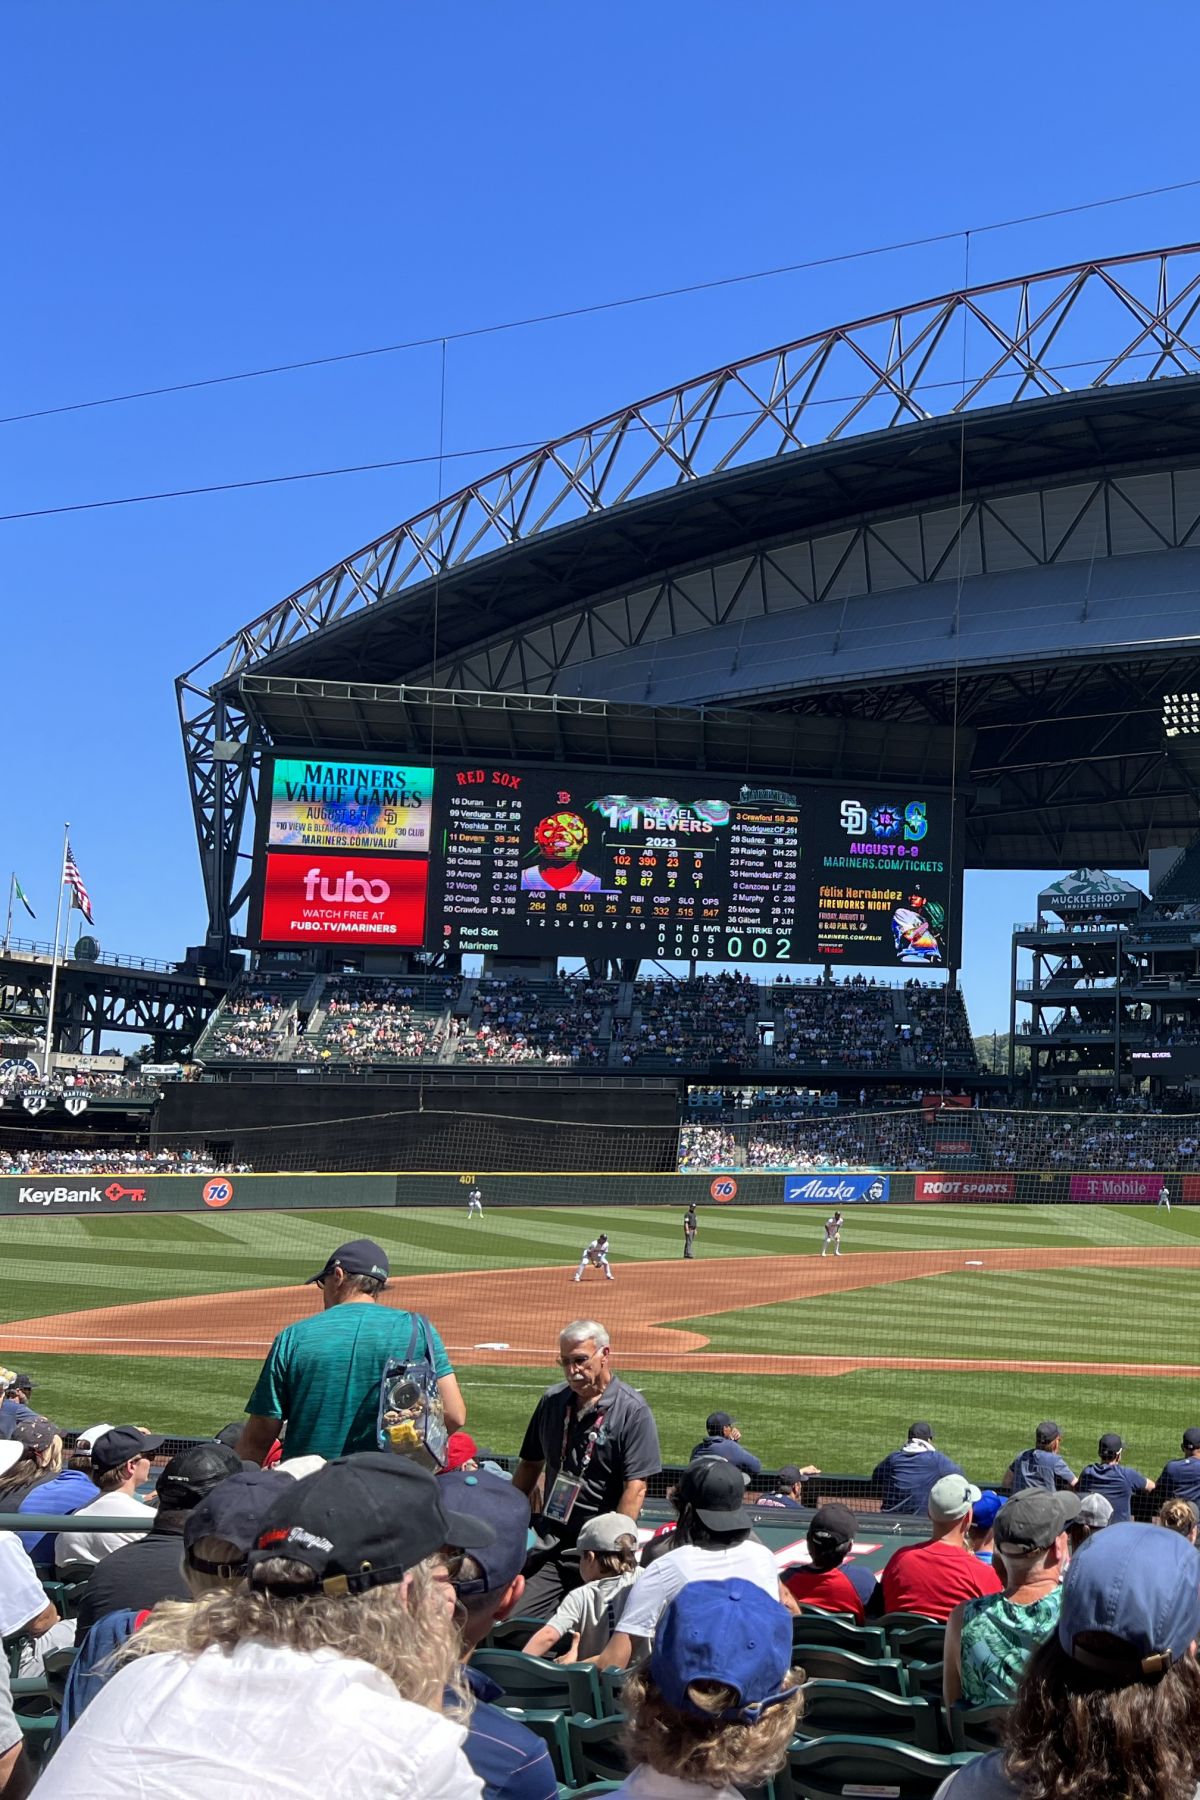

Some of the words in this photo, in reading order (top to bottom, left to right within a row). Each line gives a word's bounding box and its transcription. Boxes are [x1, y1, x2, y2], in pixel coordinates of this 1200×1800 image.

[305, 764, 406, 788] MARINERS
[456, 770, 485, 785] RED
[492, 771, 523, 790] SOX
[285, 782, 348, 803] VALUE
[354, 785, 422, 808] GAMES
[462, 798, 484, 806] Duran
[307, 807, 345, 820] AUGUST
[644, 808, 695, 820] RAFAEL
[880, 814, 893, 824] VS.
[289, 822, 306, 831] VIEW
[643, 818, 713, 833] DEVERS
[408, 828, 424, 837] CLUB
[302, 834, 398, 848] MARINERS.COM/VALUE
[645, 837, 677, 847] 2023
[850, 842, 895, 856] AUGUST
[613, 856, 631, 866] 102
[639, 857, 656, 866] 390
[667, 858, 679, 867] 23
[695, 860, 702, 868] 0
[824, 856, 944, 872] MARINERS.COM/TICKETS
[457, 870, 481, 879] Arroyo
[304, 868, 390, 904] fubo
[456, 883, 477, 891] Wong
[615, 877, 627, 886] 36
[640, 878, 653, 887] 87
[668, 879, 675, 888] 2
[695, 880, 700, 888] 1
[739, 894, 764, 902] Murphy
[820, 886, 843, 898] Félix
[846, 886, 903, 900] Hernández
[1051, 894, 1127, 904] MUCKLESHOOT
[455, 895, 479, 904] Chang
[678, 897, 694, 905] SLG
[819, 899, 864, 910] FIREWORKS
[868, 902, 891, 911] NIGHT
[454, 906, 488, 914] Crawford
[556, 903, 567, 911] 58
[579, 904, 594, 912] 103
[605, 905, 617, 913] 25
[303, 908, 340, 919] WATCH
[344, 910, 368, 920] FREE
[372, 911, 384, 921] AT
[290, 921, 397, 933] FUBO.TV/MARINERS
[726, 926, 744, 934] BALL
[746, 927, 773, 935] STRIKE
[460, 927, 478, 935] Red
[481, 927, 498, 936] Sox
[658, 933, 665, 942] 0
[676, 934, 682, 943] 0
[692, 934, 699, 943] 0
[707, 935, 714, 944] 5
[459, 941, 498, 950] Mariners
[658, 947, 664, 956] 0
[675, 947, 681, 956] 0
[691, 948, 698, 957] 0
[707, 948, 714, 957] 5
[728, 936, 742, 957] 0
[752, 938, 766, 958] 0
[776, 938, 790, 959] 2
[63, 1090, 93, 1098] MARTINEZ
[28, 1097, 41, 1109] 24
[71, 1100, 81, 1111] 11
[460, 1175, 475, 1184] 401
[208, 1186, 228, 1200] 76
[714, 1183, 733, 1195] 76
[789, 1180, 855, 1200] Alaska
[923, 1182, 960, 1194] ROOT
[962, 1184, 1008, 1193] SPORTS
[1102, 1180, 1146, 1195] Mobile
[18, 1186, 102, 1206] KeyBank
